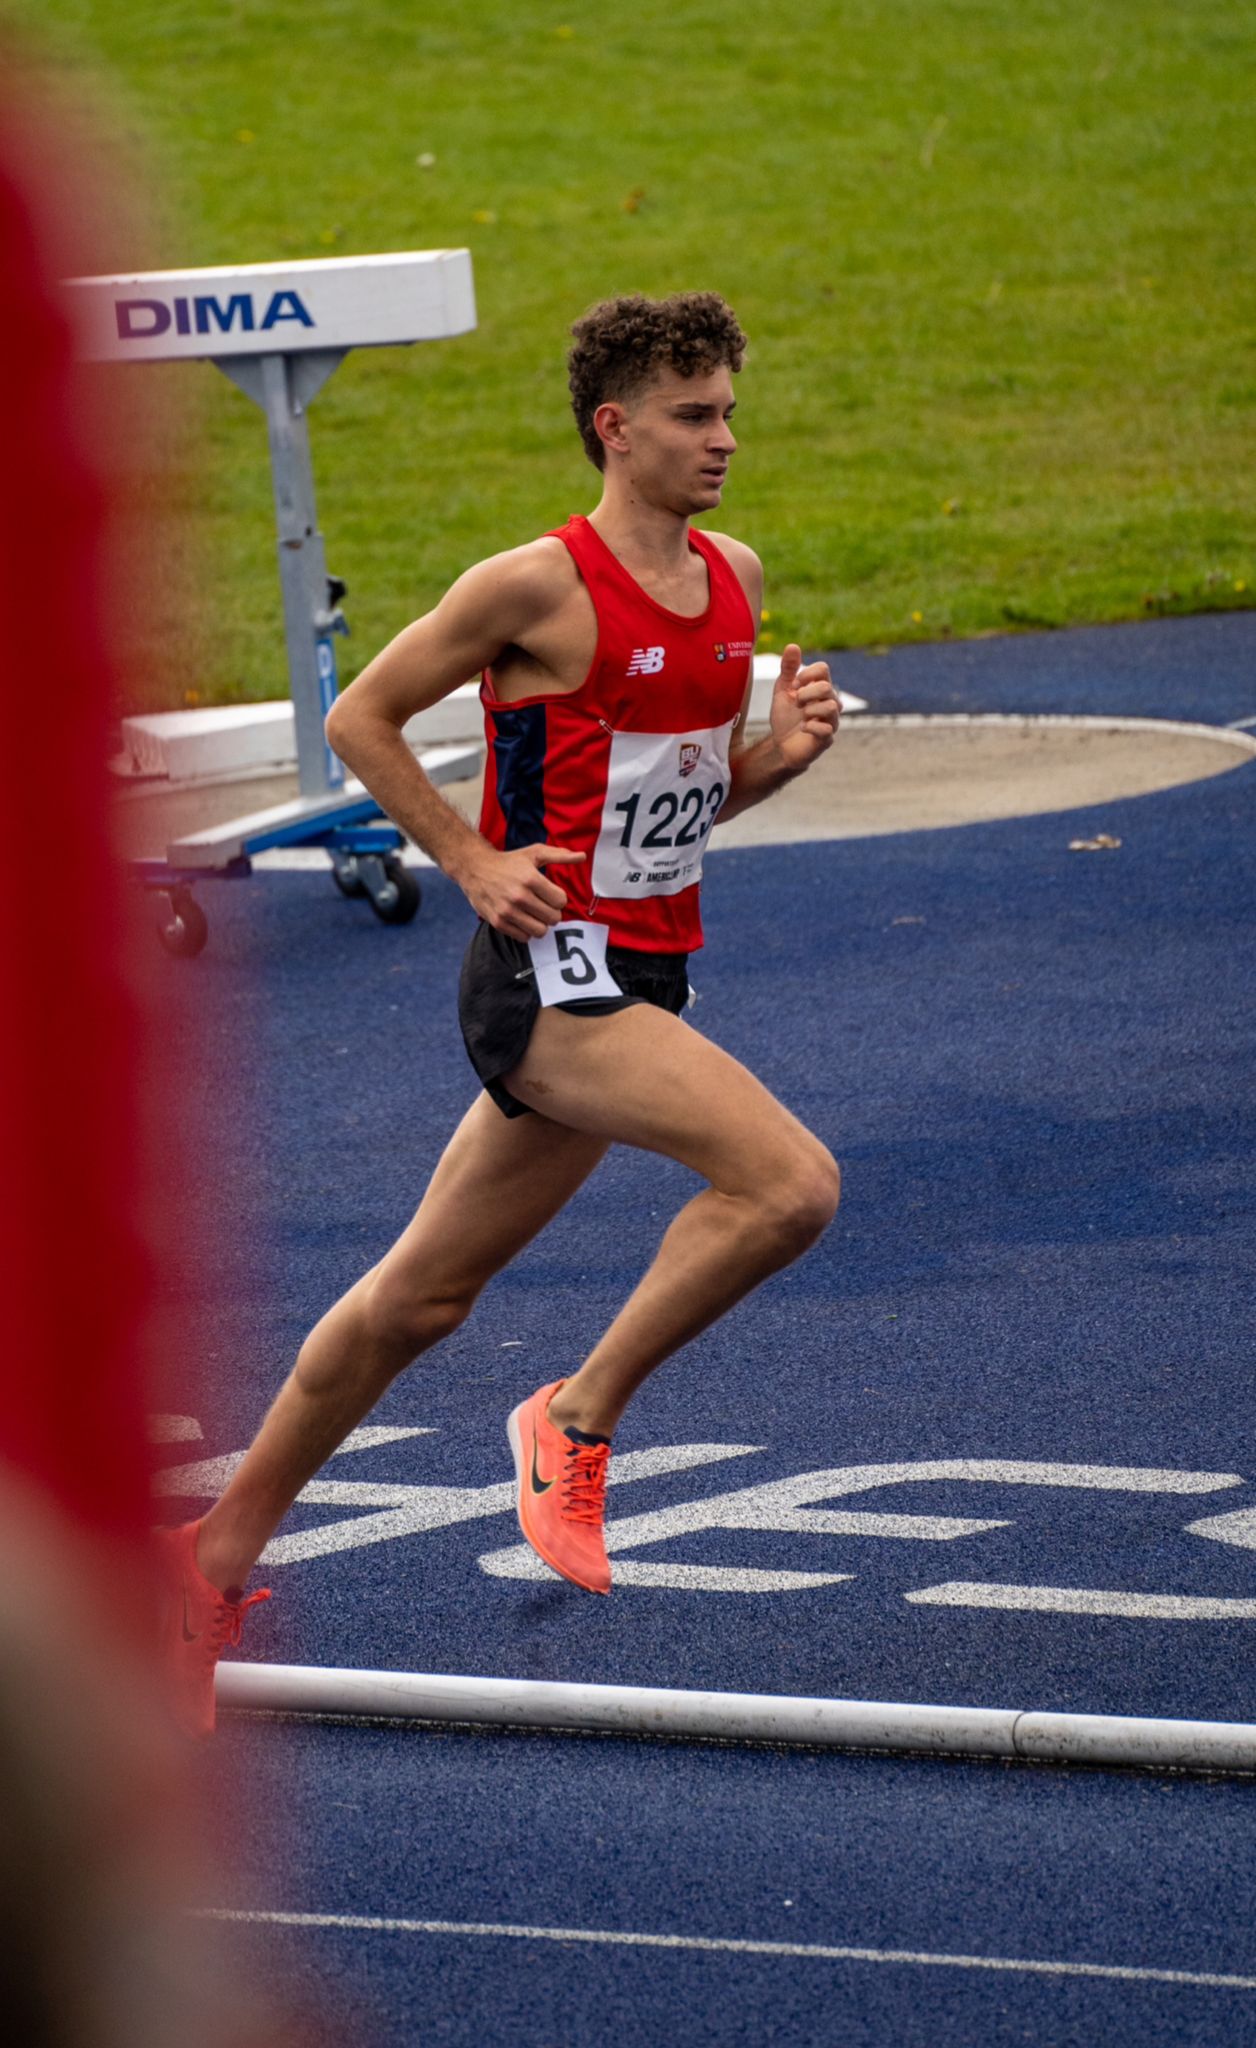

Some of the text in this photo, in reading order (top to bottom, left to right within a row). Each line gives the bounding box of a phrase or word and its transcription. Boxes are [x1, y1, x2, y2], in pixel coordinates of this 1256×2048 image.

[115, 289, 316, 340] DIMA
[615, 782, 724, 848] 1223
[554, 928, 597, 986] 5
